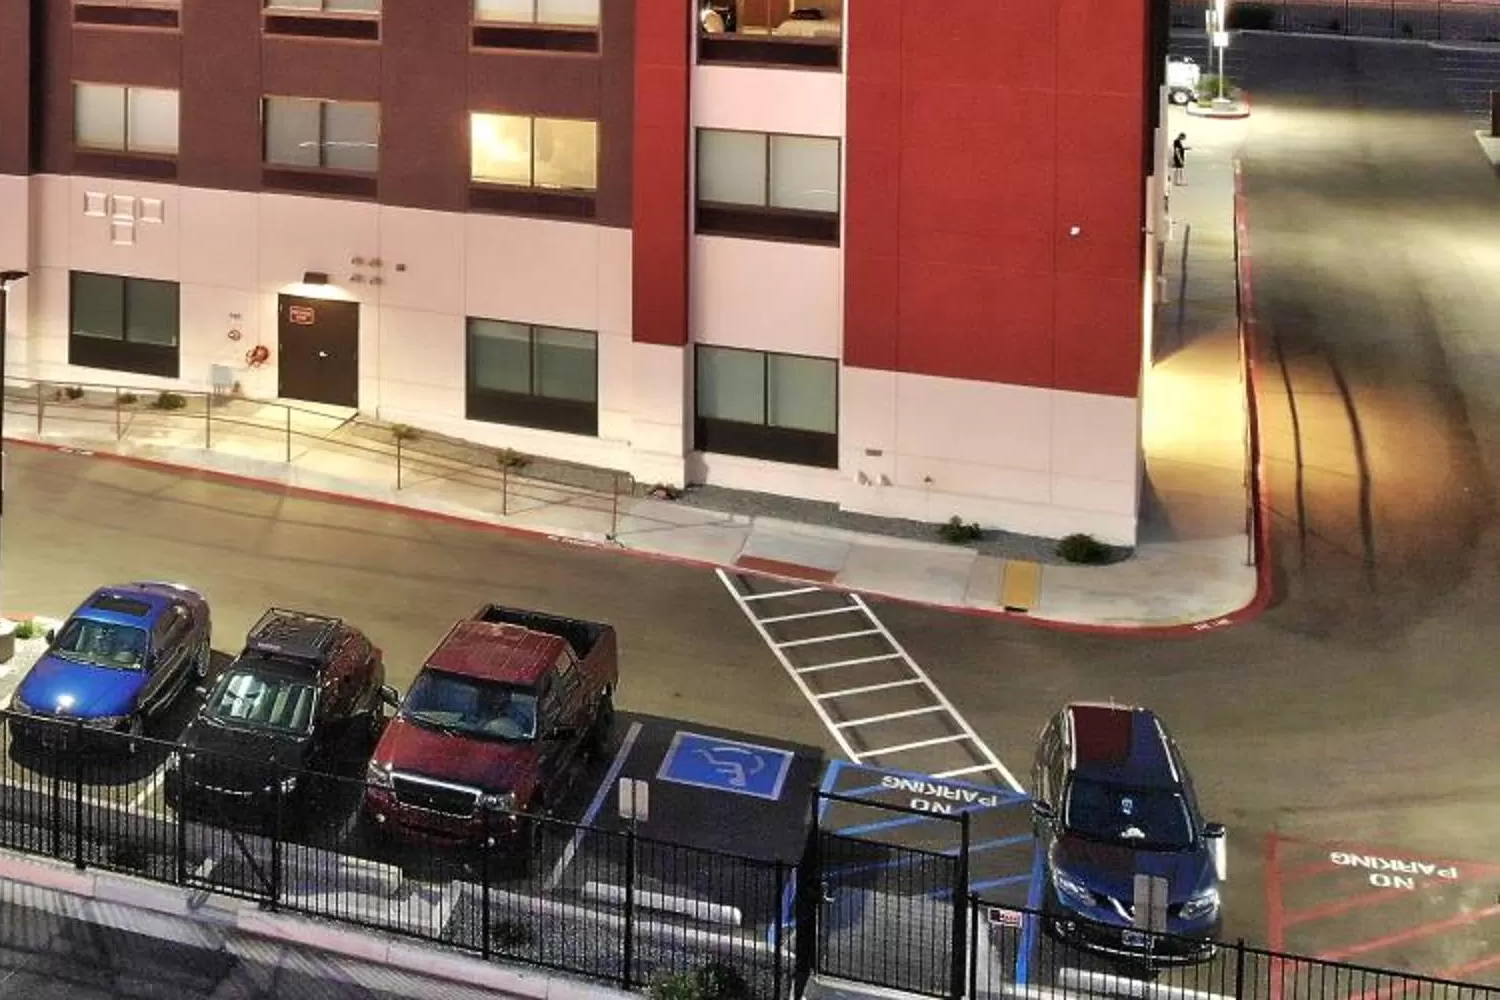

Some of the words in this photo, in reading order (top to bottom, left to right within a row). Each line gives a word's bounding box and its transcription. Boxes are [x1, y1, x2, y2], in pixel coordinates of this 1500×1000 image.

[881, 775, 997, 807] PARKING
[910, 798, 952, 814] NO
[1329, 851, 1459, 879] PARKING
[1368, 873, 1416, 890] NO
